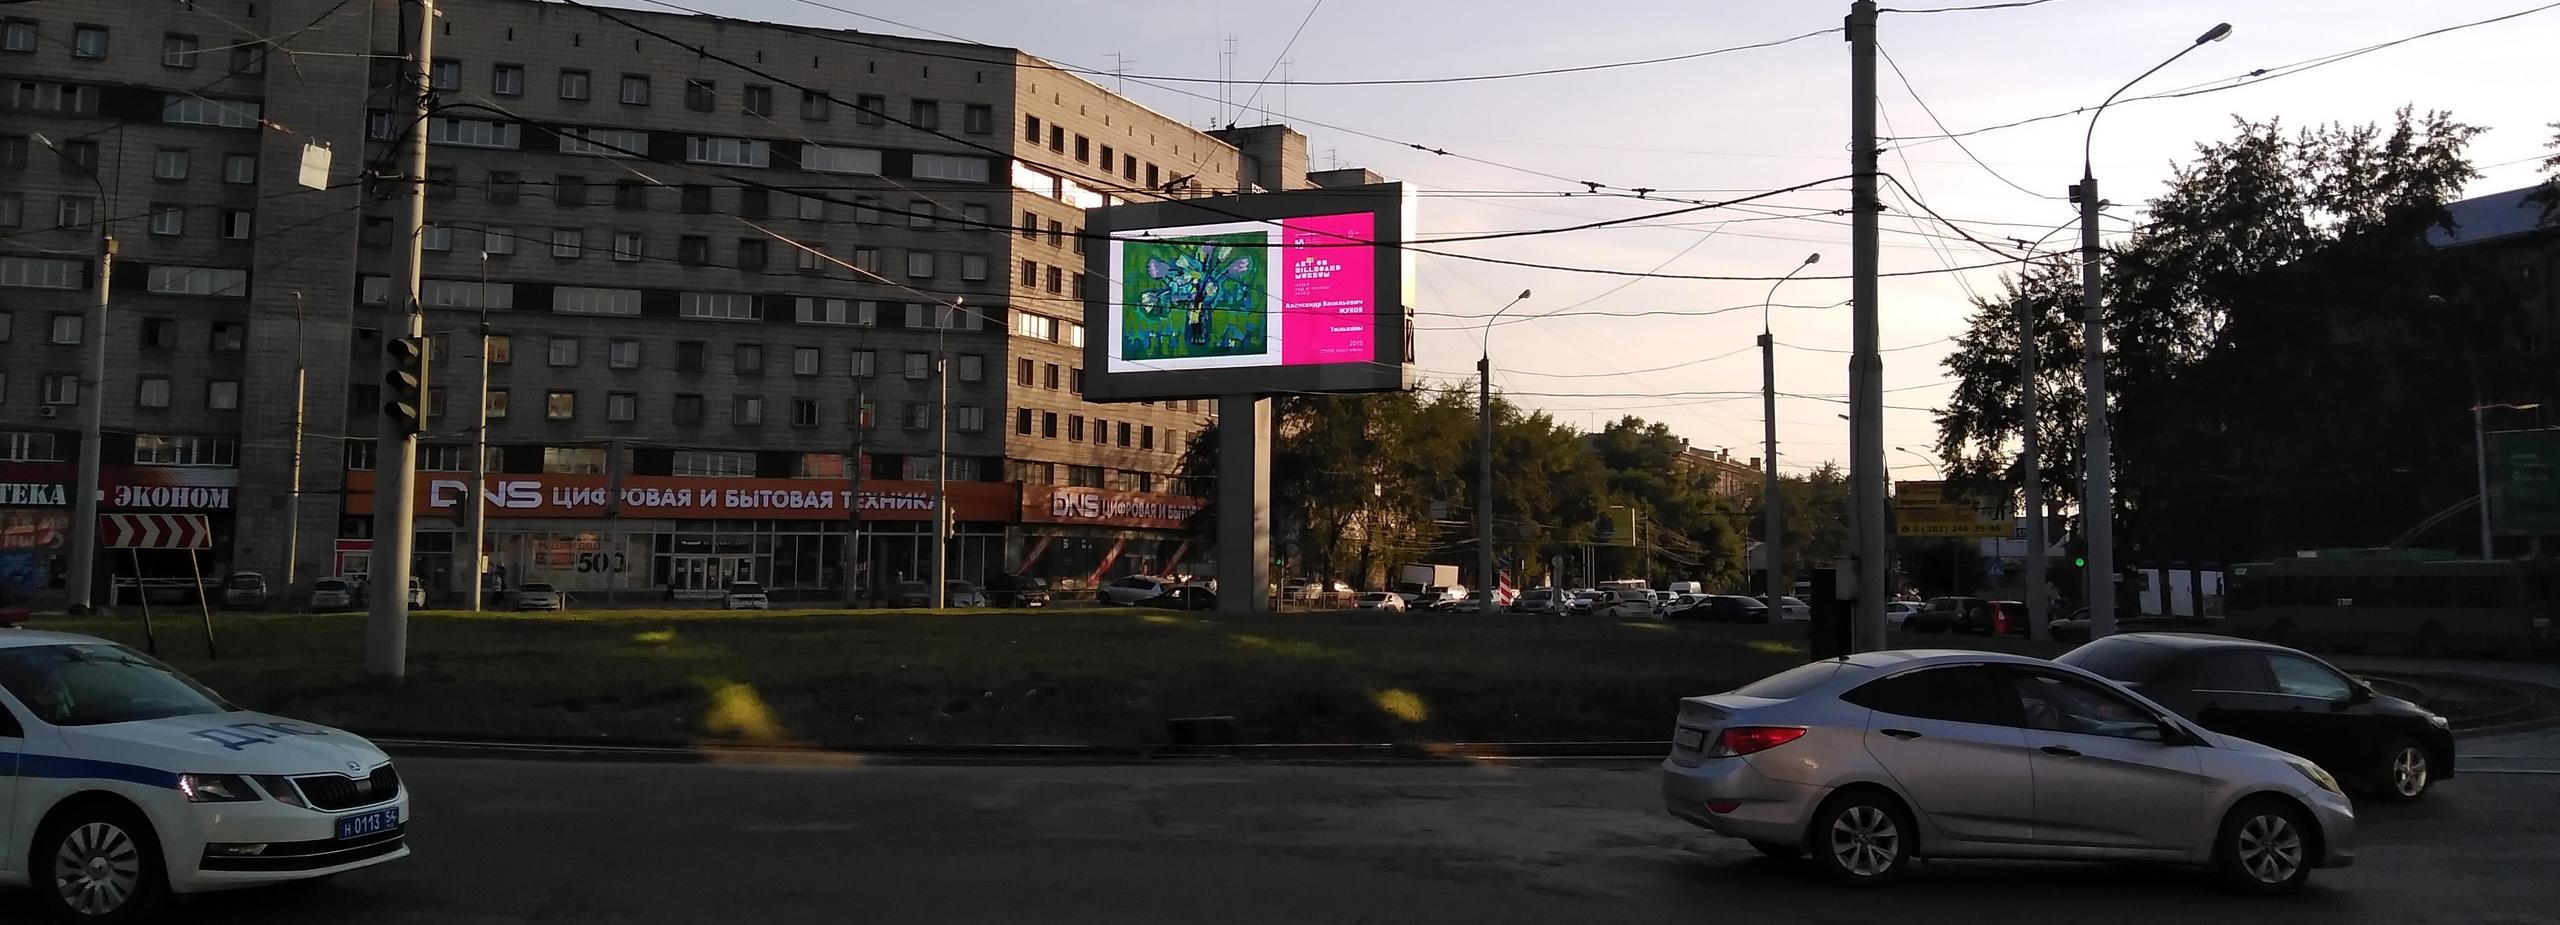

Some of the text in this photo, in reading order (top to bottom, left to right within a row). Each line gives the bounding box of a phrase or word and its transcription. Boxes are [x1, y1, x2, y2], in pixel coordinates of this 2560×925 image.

[114, 484, 230, 509] ЭКОНОМ
[430, 479, 543, 509] DNS
[700, 488, 717, 507] И
[725, 488, 834, 510] БЫТОВАЯ
[1053, 490, 1100, 518] DNS
[1102, 499, 1157, 519] ЦИФРОВАЯ
[1158, 503, 1167, 519] И
[188, 722, 329, 751] ДПС
[344, 823, 351, 836] Н
[354, 813, 381, 833] 0113
[385, 810, 398, 824] 54
